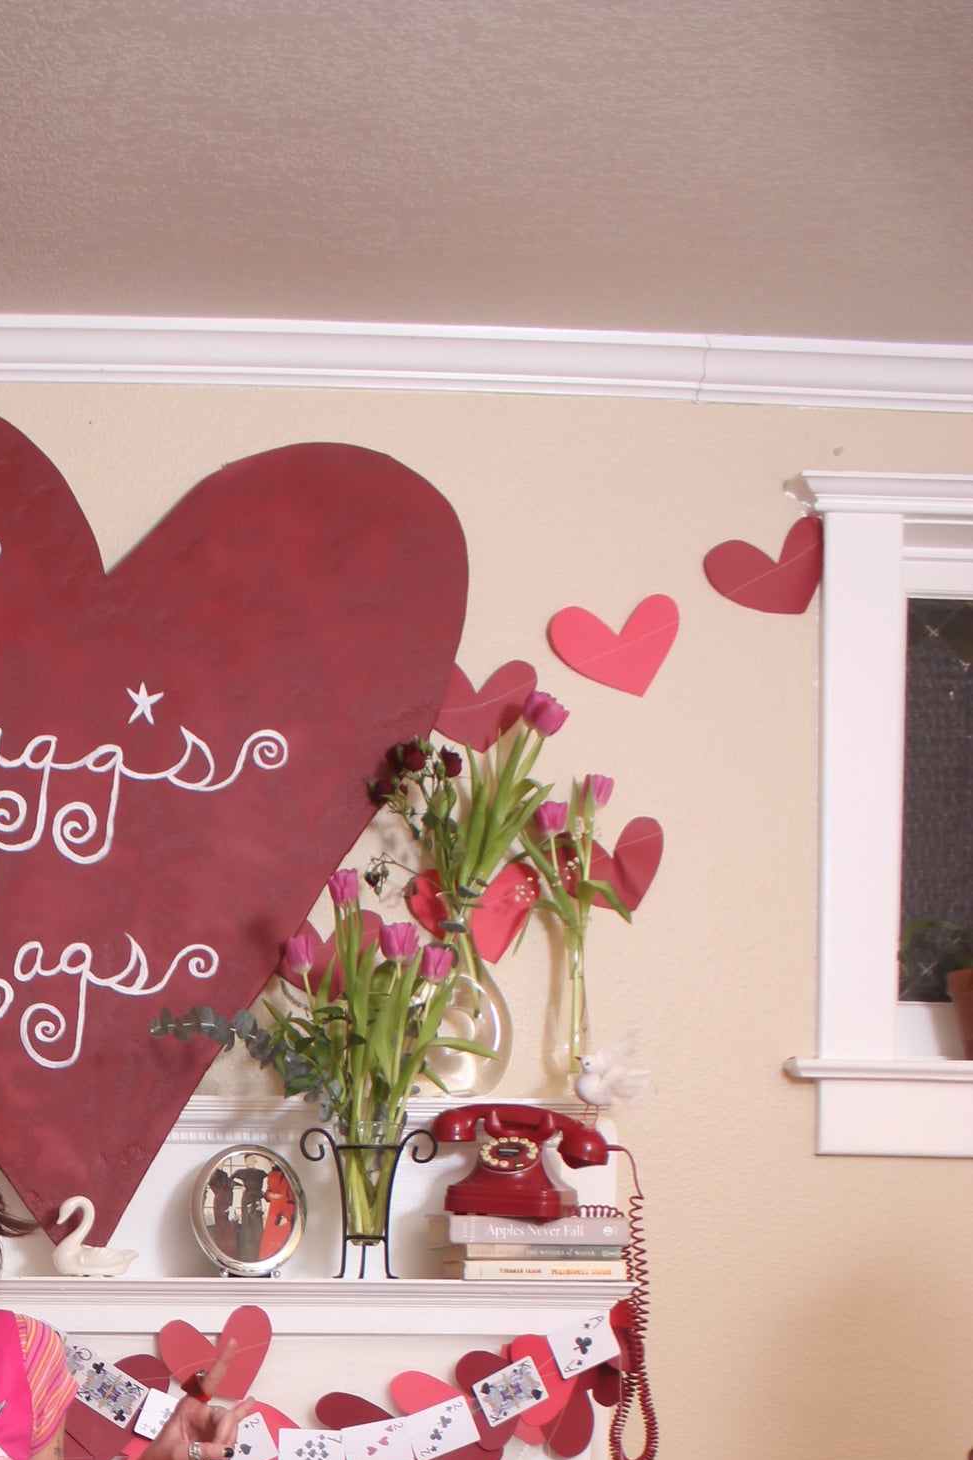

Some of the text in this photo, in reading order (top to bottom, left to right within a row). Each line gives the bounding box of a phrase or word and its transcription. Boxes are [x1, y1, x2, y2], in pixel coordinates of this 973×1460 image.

[486, 1223, 524, 1239] Apples
[527, 1225, 560, 1237] Never
[563, 1225, 584, 1237] Fall
